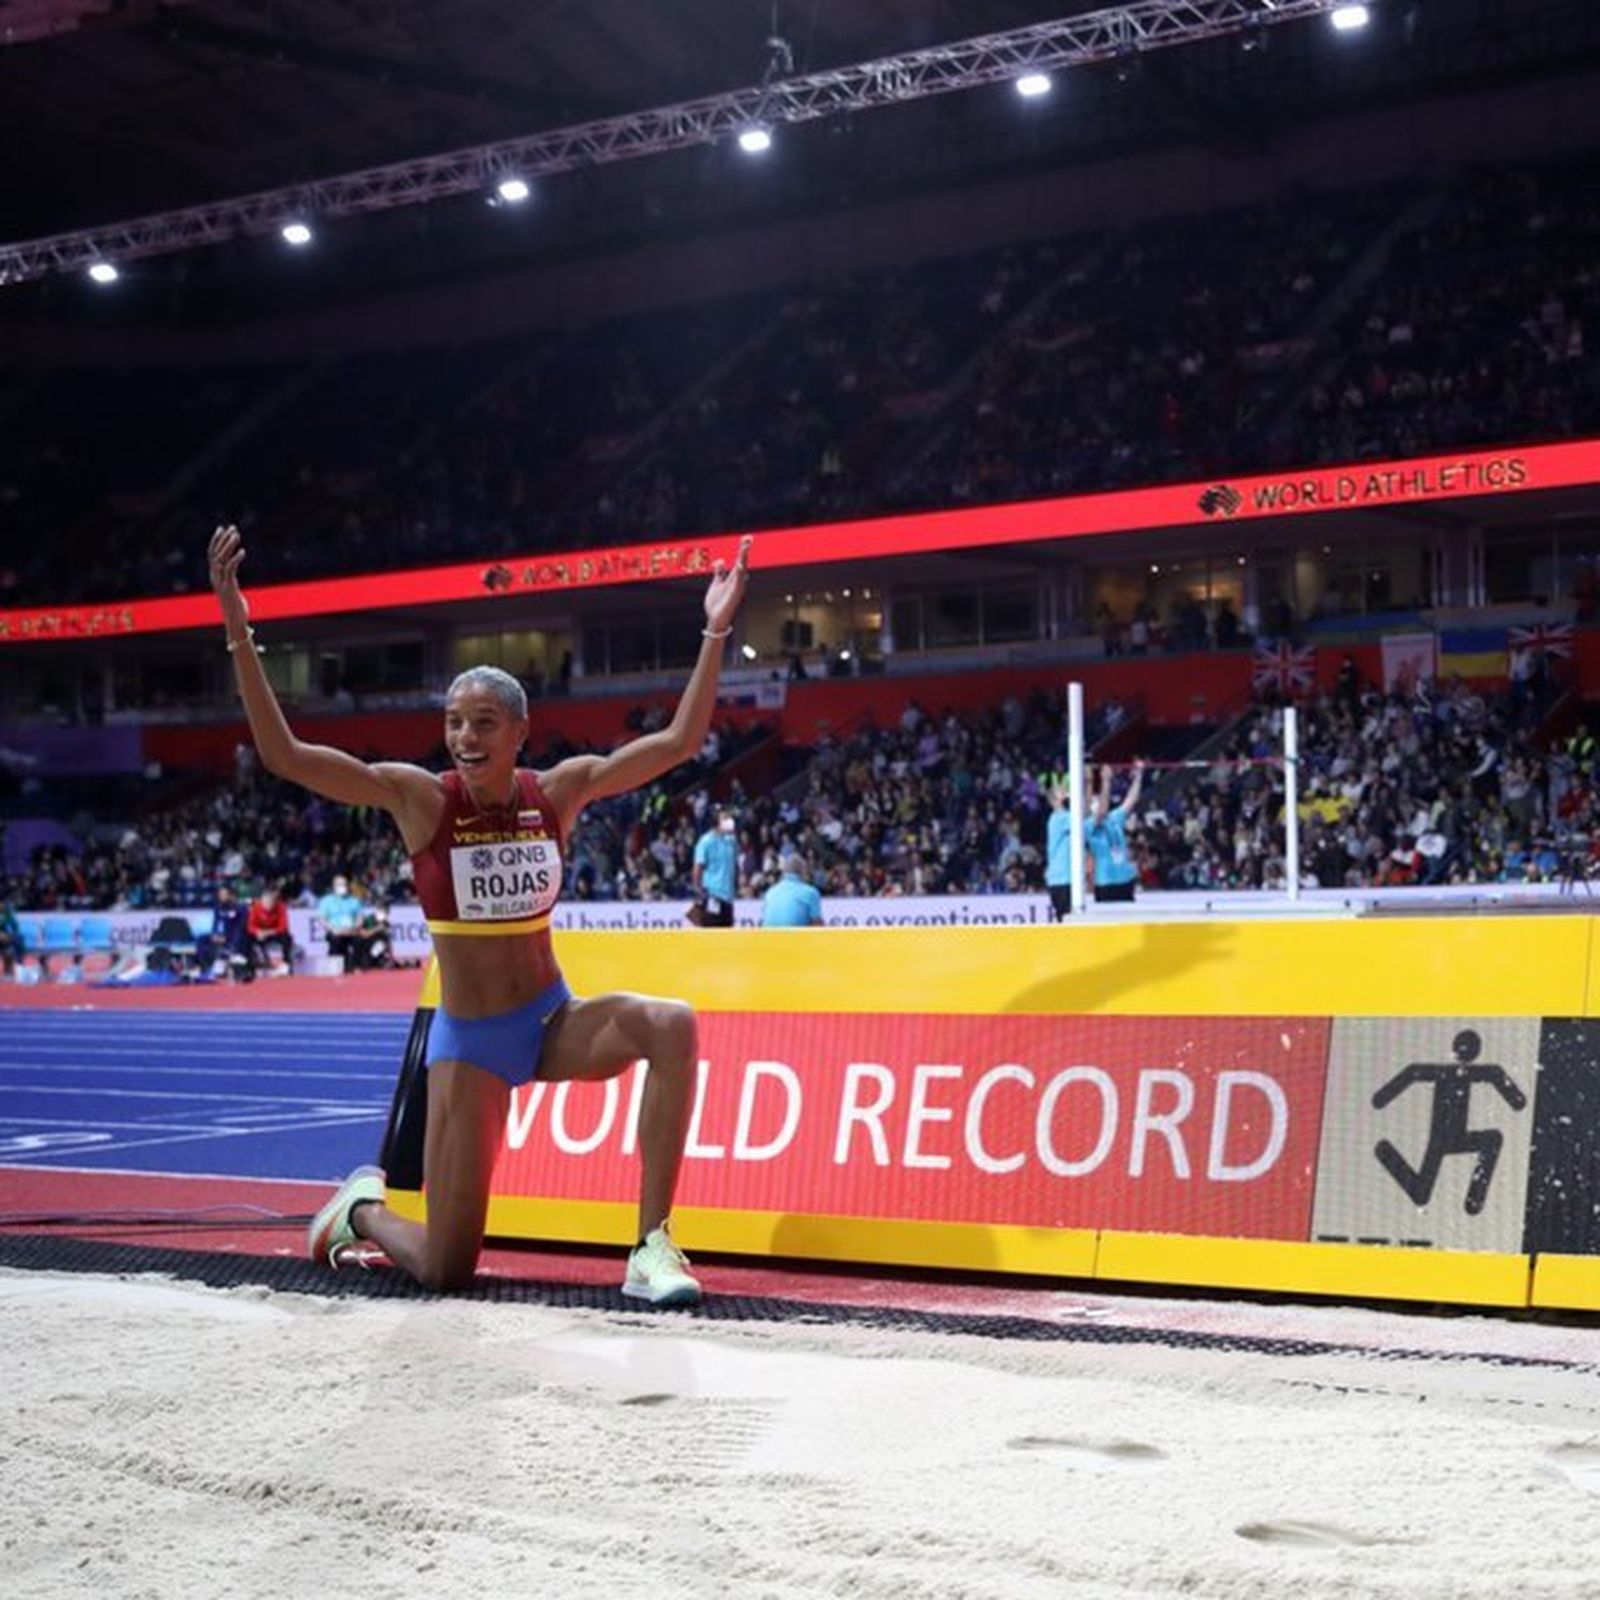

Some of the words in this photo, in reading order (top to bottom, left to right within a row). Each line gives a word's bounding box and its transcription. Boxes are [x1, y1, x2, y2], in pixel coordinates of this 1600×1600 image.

[1253, 479, 1356, 511] WORLD
[1363, 459, 1526, 500] ATHLETICS
[498, 845, 547, 867] QNB
[470, 869, 549, 899] ROJAS
[833, 1062, 1290, 1183] RECORD
